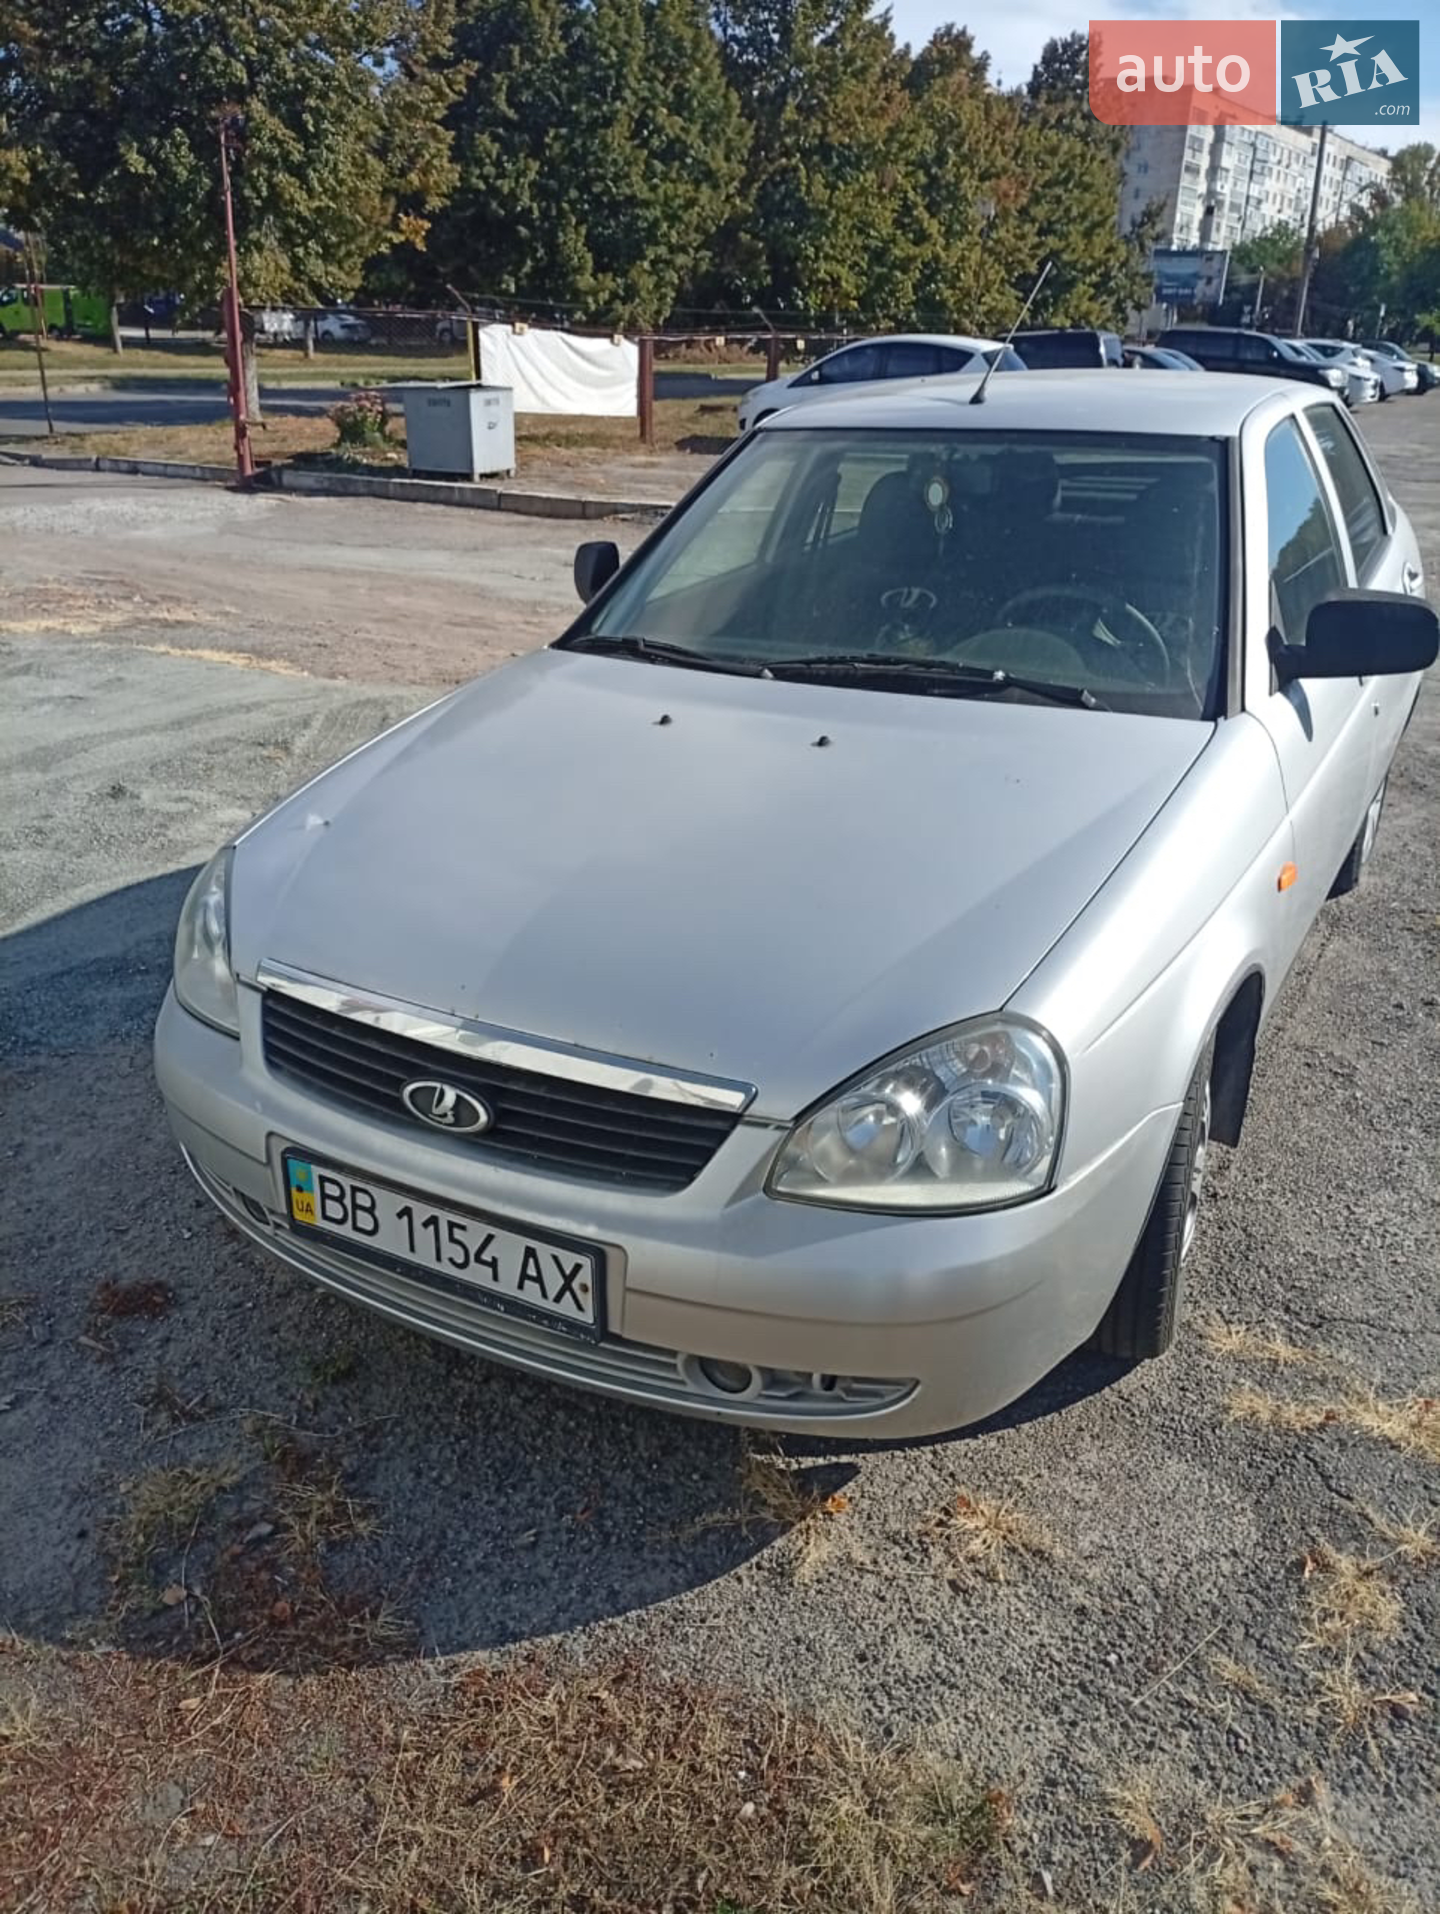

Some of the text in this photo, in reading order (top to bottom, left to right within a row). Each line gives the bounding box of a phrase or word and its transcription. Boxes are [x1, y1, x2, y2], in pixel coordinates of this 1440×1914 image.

[295, 1198, 314, 1217] UA
[318, 1174, 587, 1314] BB 1154 AX
